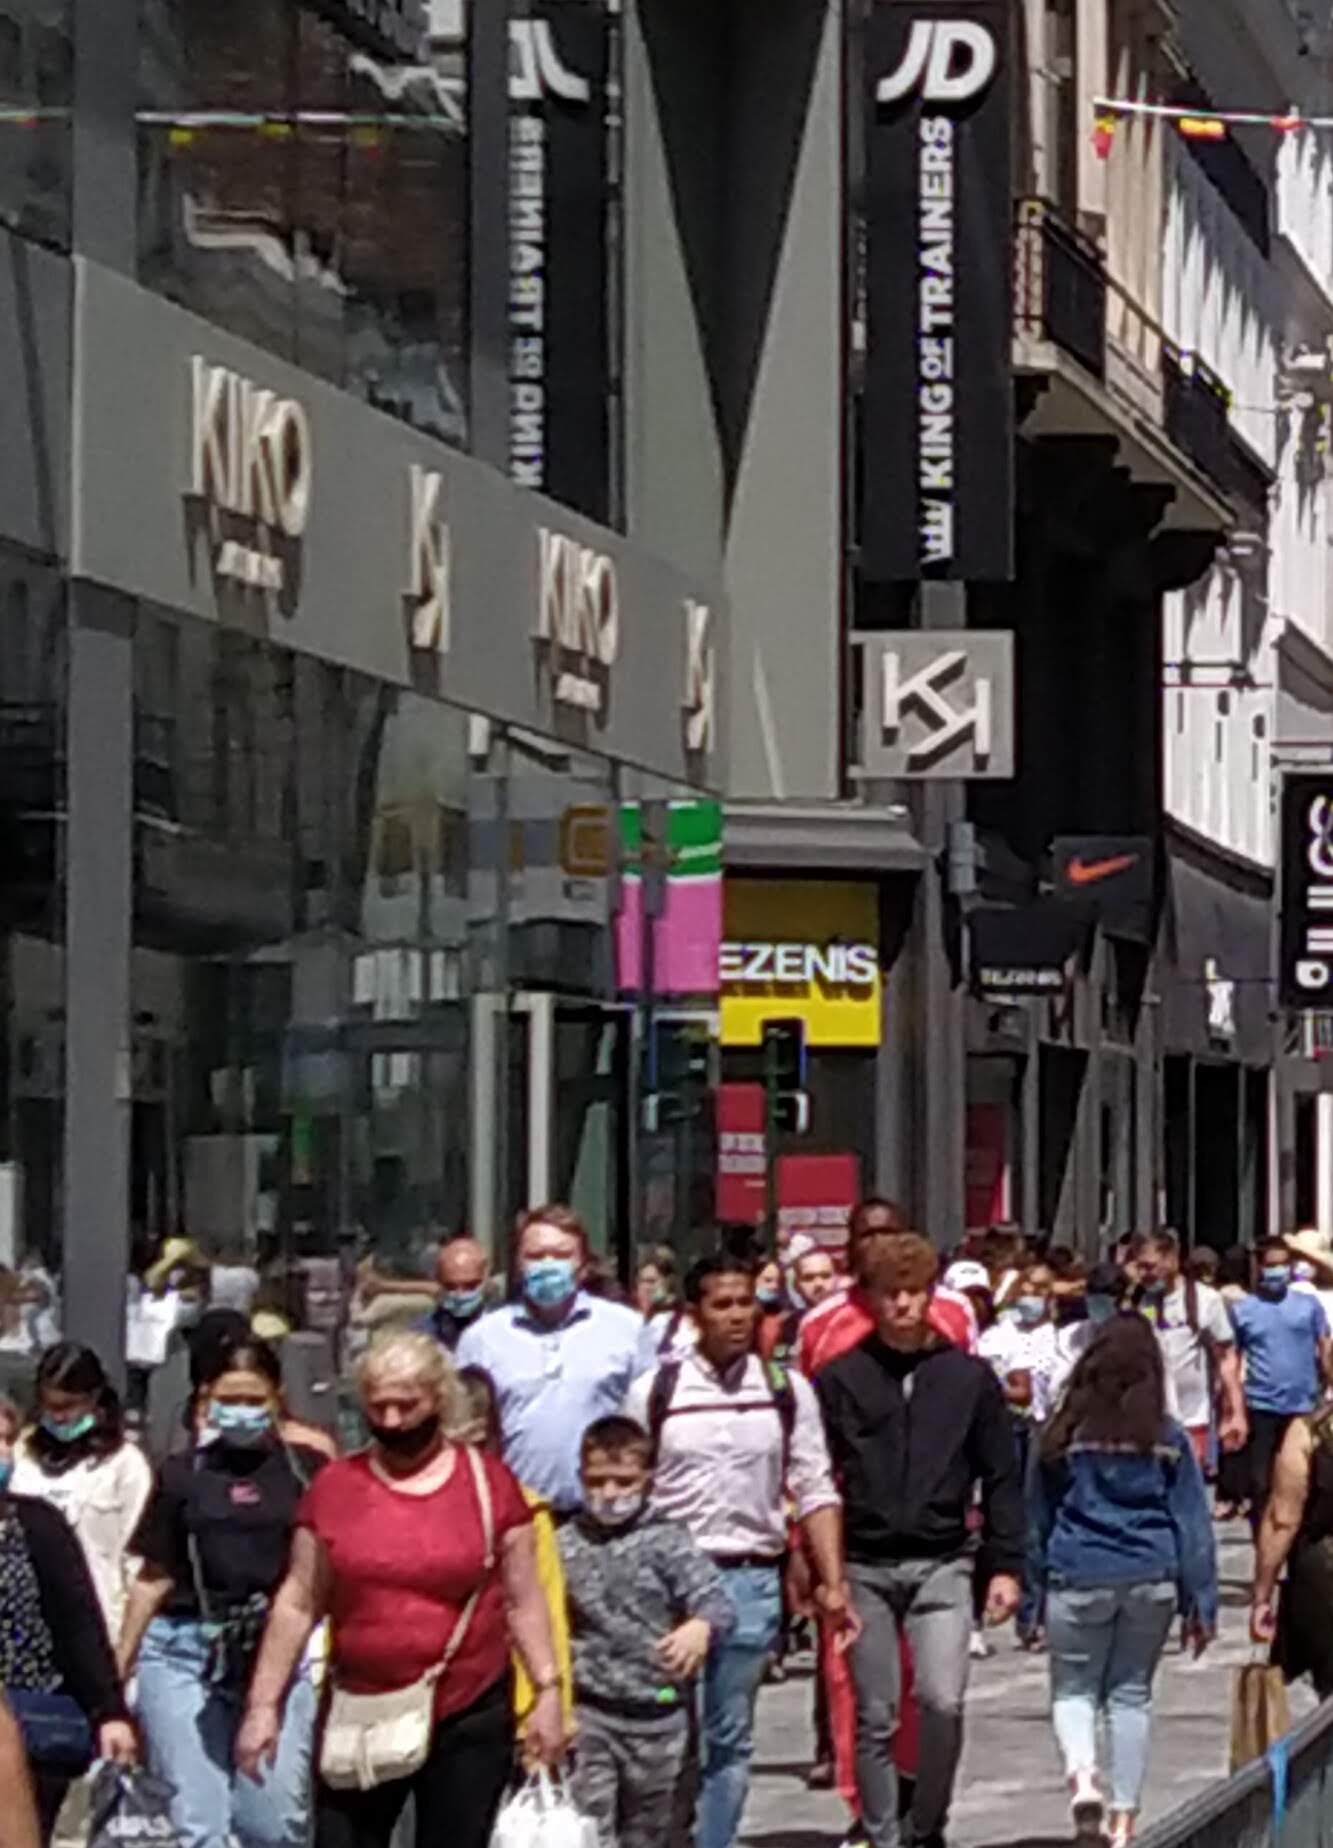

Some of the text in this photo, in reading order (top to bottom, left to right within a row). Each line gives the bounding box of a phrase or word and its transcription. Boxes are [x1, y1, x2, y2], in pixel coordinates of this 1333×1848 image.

[877, 19, 995, 103] JD
[919, 115, 954, 489] KING OF TRAINERS
[193, 354, 312, 536] KIKO
[538, 526, 618, 665] KIKO
[718, 944, 879, 982] EZENIS
